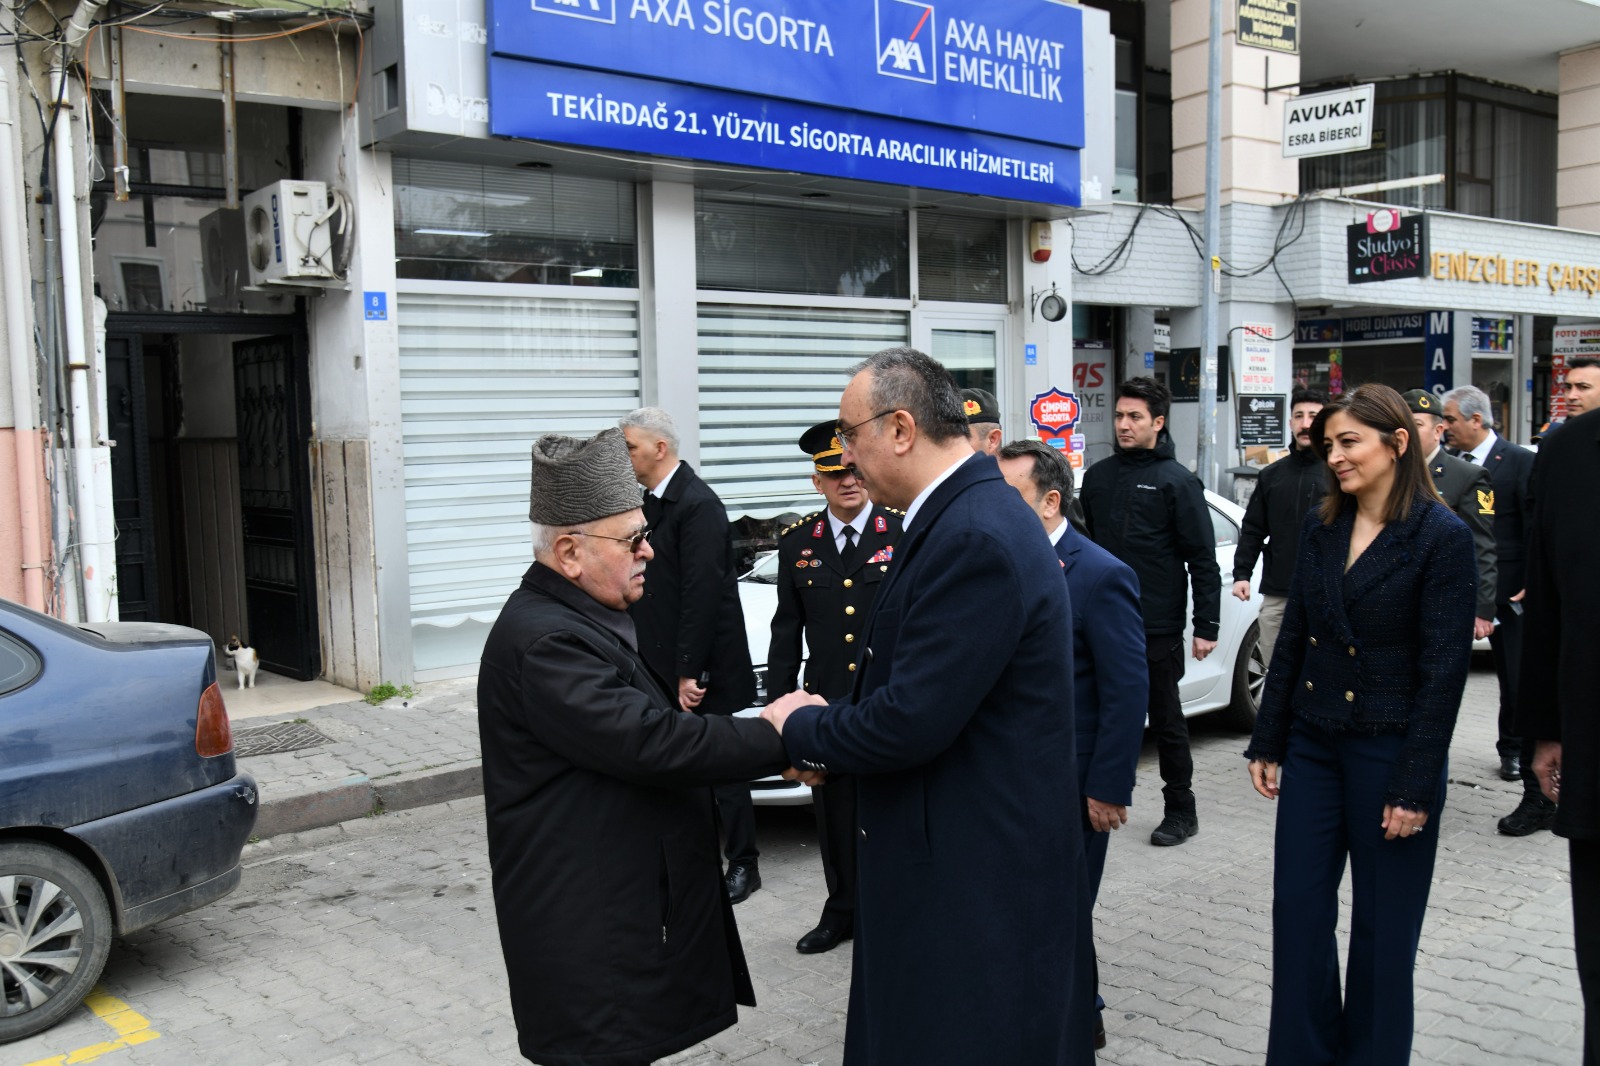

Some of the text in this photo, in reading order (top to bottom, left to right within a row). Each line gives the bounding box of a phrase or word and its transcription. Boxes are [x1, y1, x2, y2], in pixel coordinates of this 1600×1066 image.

[630, 0, 834, 57] AXA SİGORTA
[879, 38, 926, 73] AXA
[944, 17, 1064, 70] AXA HAYAT
[944, 51, 1063, 103] EMEKLİLİK
[1289, 98, 1366, 124] AVUKAT
[547, 92, 1054, 184] TEKİRDAĞ 21. YÜZYIL SİGORTA ARACILIK HİZMETLERİ
[1288, 123, 1362, 147] ESRA BİBERCİ
[271, 193, 282, 263] BEKO
[1357, 232, 1411, 258] Studyo
[1431, 250, 1541, 287] ENİZCİLER
[372, 296, 379, 307] 8
[1244, 325, 1273, 337] DEFNE
[1345, 314, 1422, 332] HOBİ DÜNYASI
[1555, 330, 1577, 338] FOTO
[1575, 345, 1600, 353] VESİKA
[1076, 391, 1105, 408] İYE
[1041, 412, 1071, 423] SİGORTA
